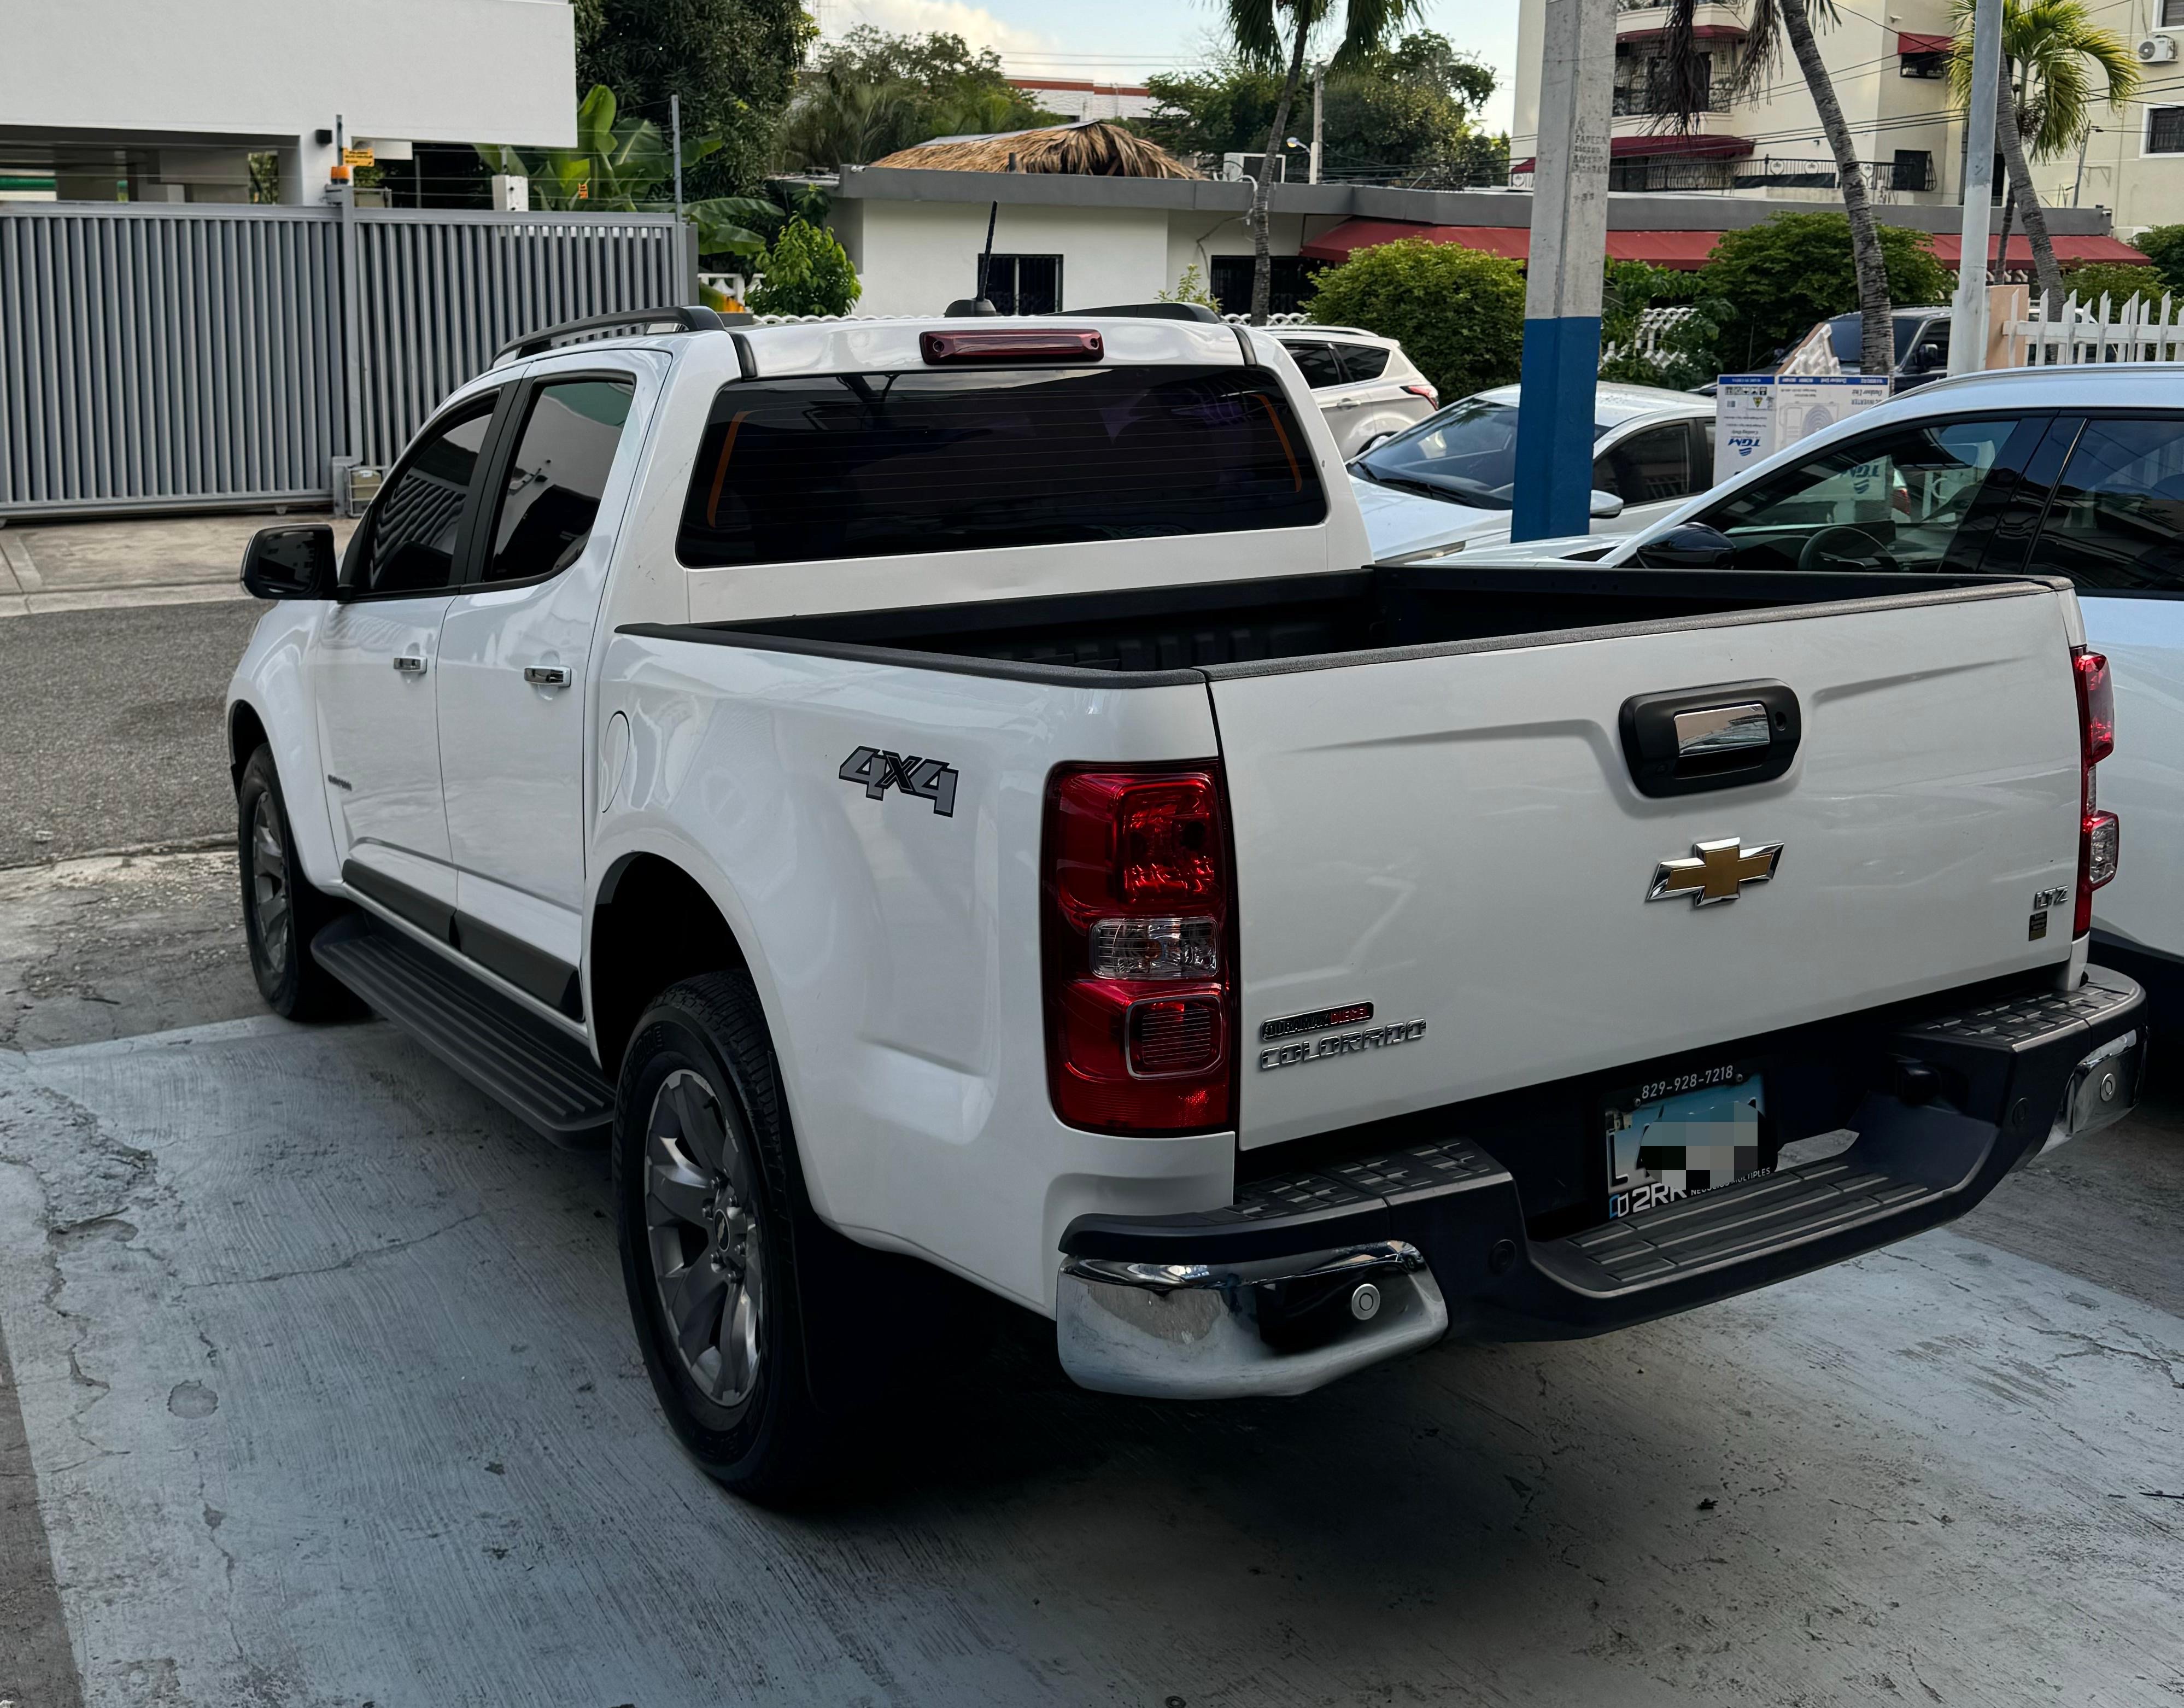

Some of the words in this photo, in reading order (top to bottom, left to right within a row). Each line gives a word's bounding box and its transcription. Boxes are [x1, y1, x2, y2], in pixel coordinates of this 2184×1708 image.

[1728, 438, 1760, 447] TGM
[2034, 885, 2069, 909] LTZ
[1263, 1014, 1330, 1038] DURAMAX
[1330, 1005, 1370, 1025] DIESEL
[1261, 1019, 1426, 1068] COLORADO
[1642, 1065, 1734, 1099] 829-928-7218
